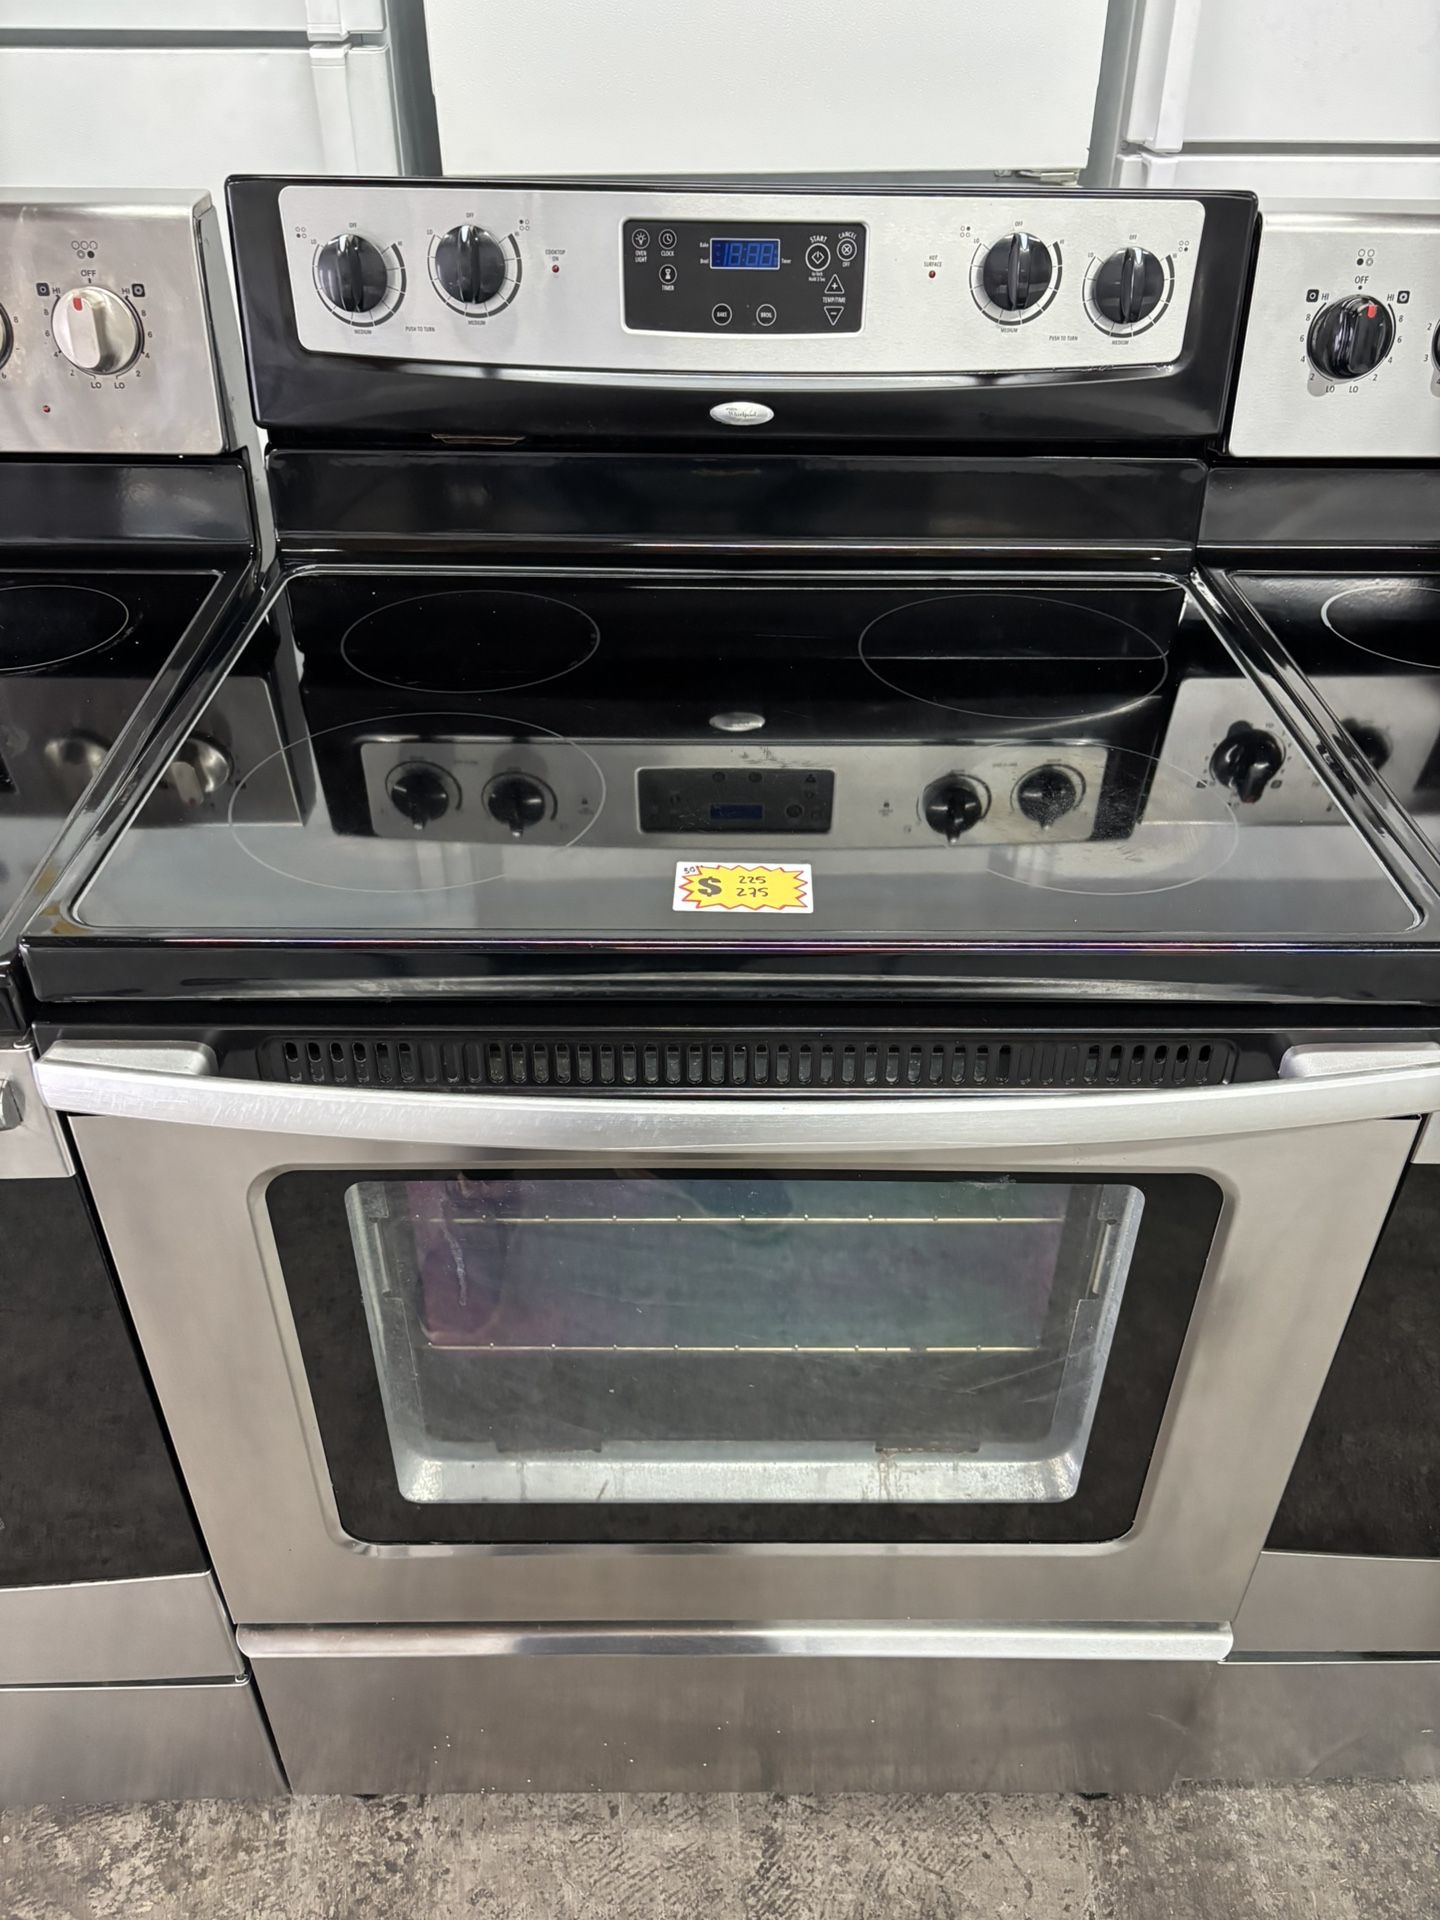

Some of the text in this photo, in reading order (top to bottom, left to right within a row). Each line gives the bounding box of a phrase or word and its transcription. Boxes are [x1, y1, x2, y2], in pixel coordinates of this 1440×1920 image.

[810, 235, 827, 243] START
[838, 231, 857, 240] CANCEL
[1354, 276, 1369, 284] OFF
[1427, 323, 1432, 331] 2
[1423, 354, 1429, 362] 3
[1325, 385, 1335, 393] LO
[697, 875, 766, 897] $ 225
[736, 888, 769, 897] 275
